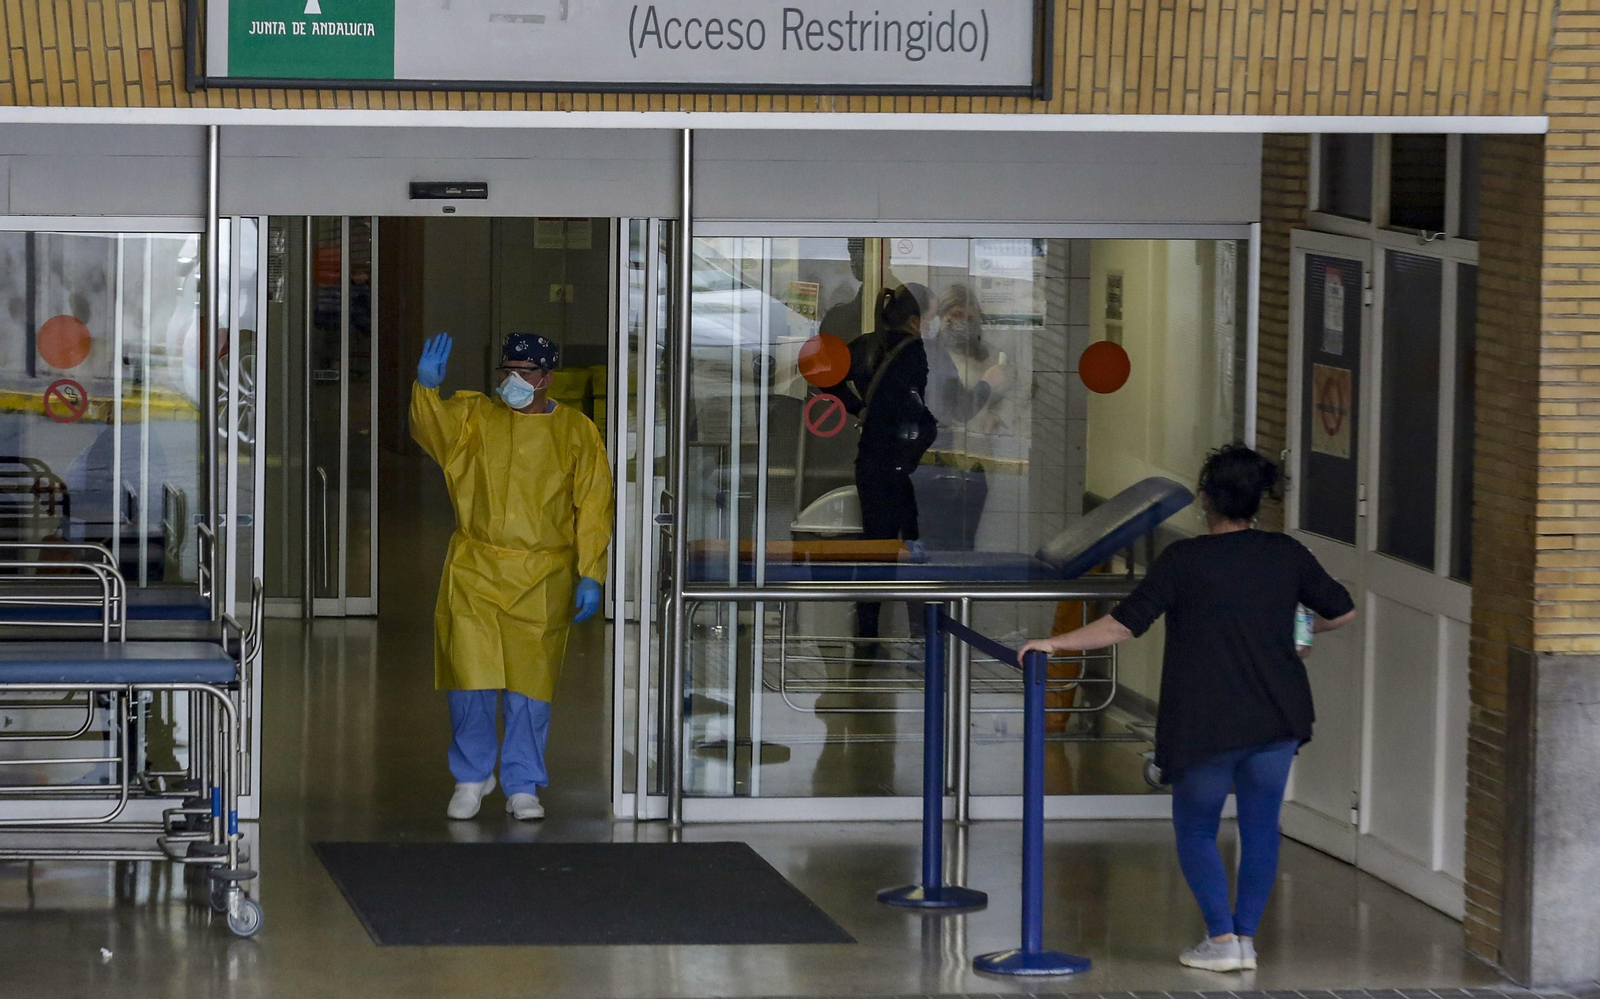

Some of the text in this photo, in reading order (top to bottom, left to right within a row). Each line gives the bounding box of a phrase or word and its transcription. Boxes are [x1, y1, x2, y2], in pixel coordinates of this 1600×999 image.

[248, 21, 376, 37] JUNTA DE ANDALUCIA
[629, 4, 989, 62] (Acceso Restringido)
